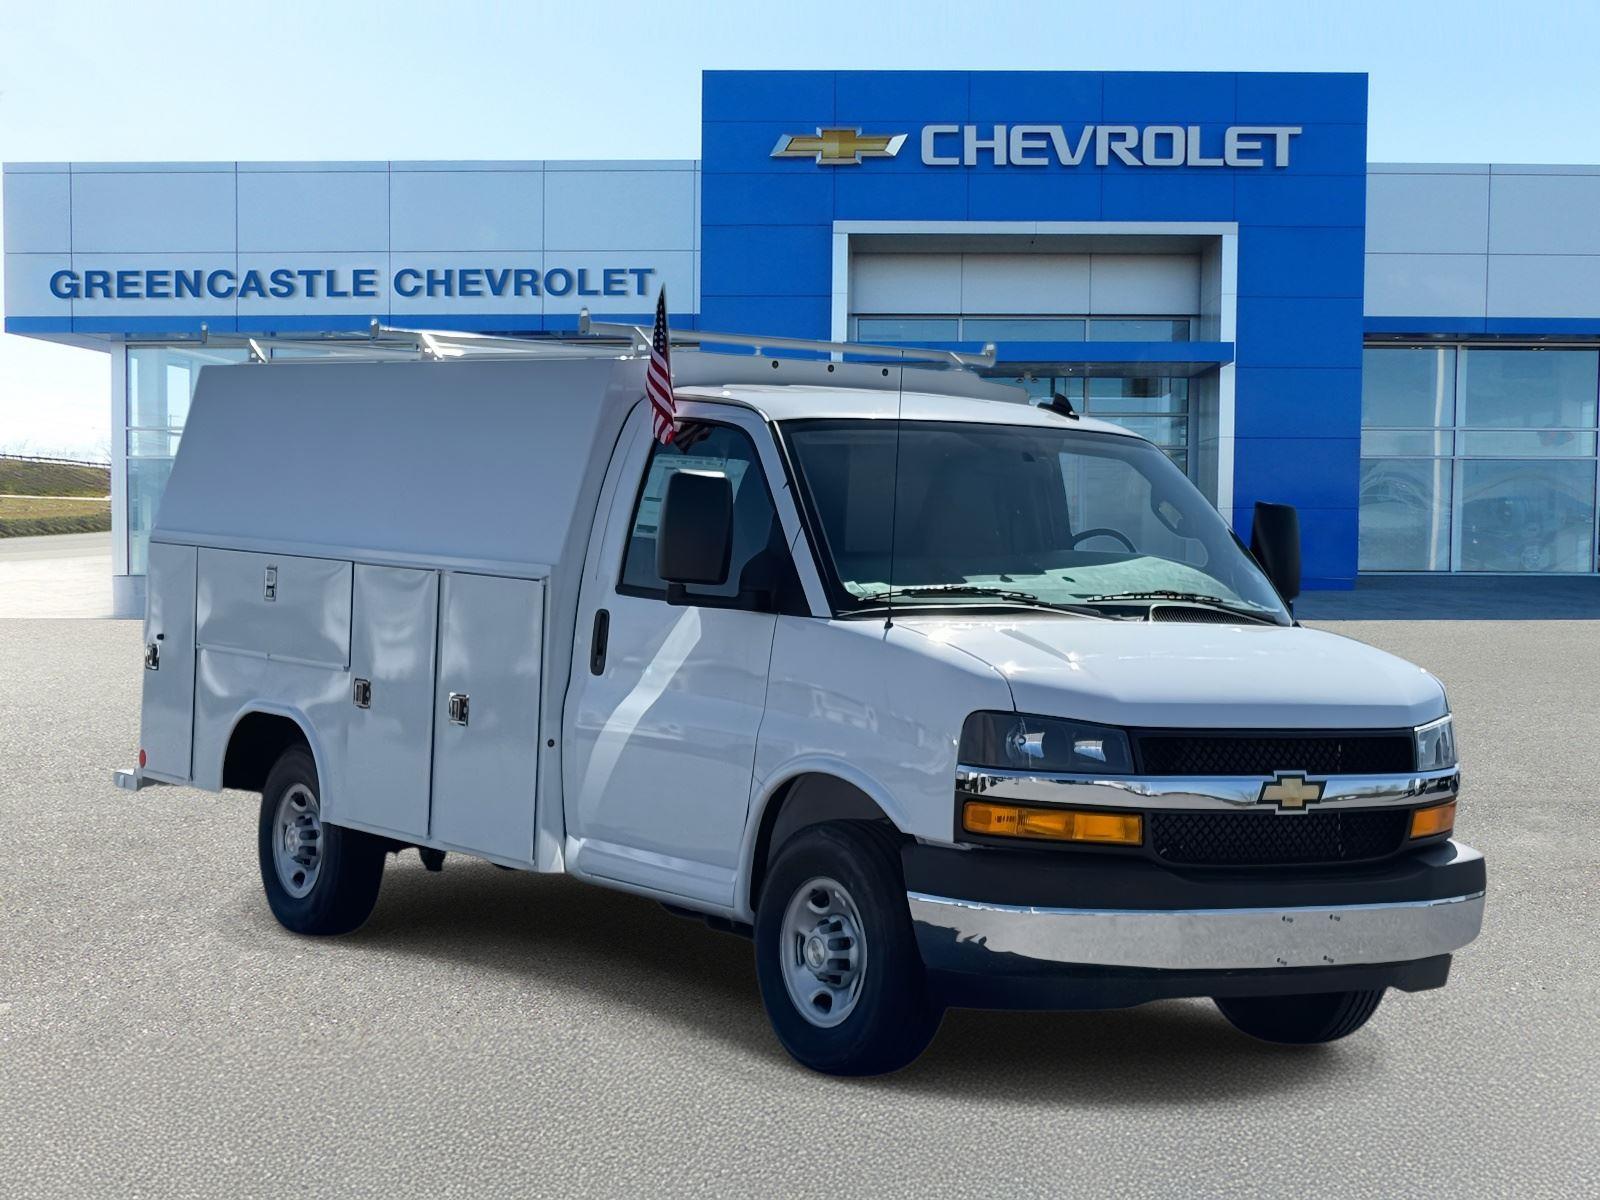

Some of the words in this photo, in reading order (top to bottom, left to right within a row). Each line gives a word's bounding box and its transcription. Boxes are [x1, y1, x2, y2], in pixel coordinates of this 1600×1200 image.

[921, 125, 1302, 167] CHEVROLET
[50, 269, 377, 299] GREENCASTLE
[394, 268, 654, 297] CHEVROLET
